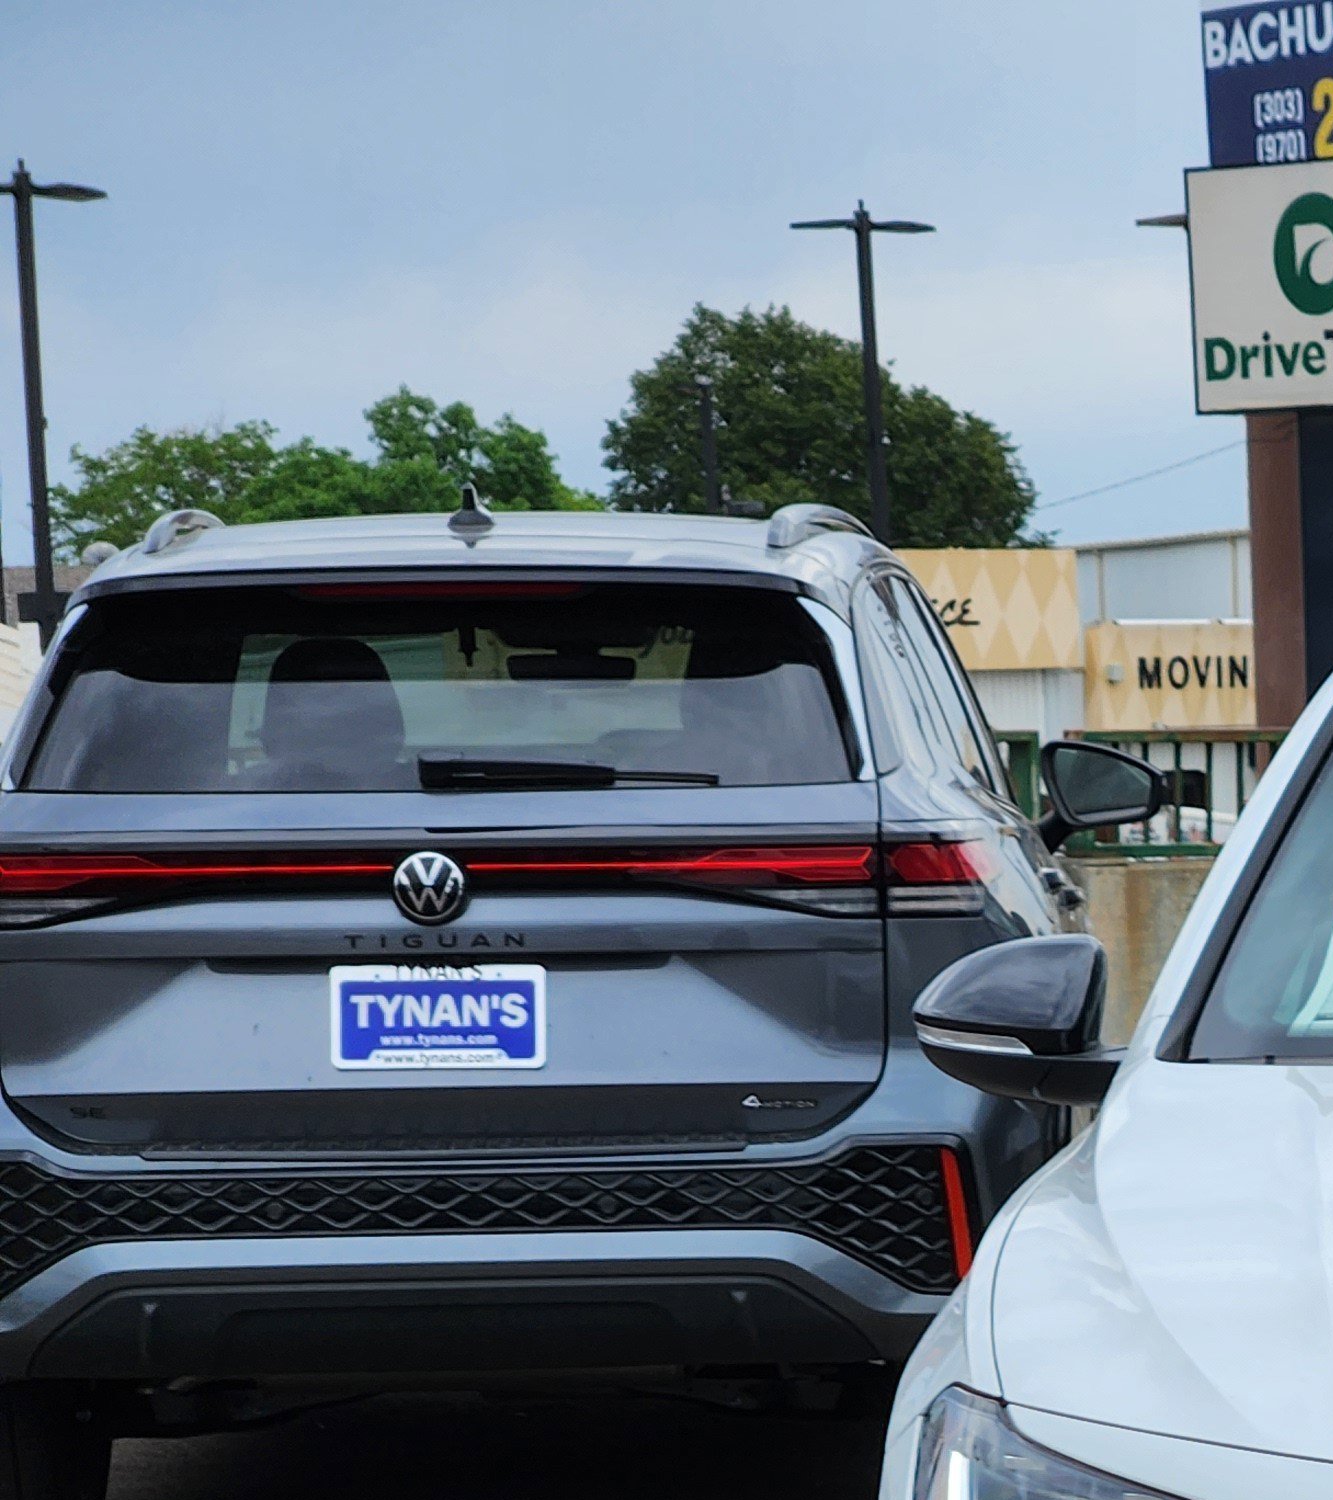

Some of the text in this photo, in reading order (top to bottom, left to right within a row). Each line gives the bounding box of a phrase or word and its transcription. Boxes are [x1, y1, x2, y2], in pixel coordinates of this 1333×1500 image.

[1137, 654, 1249, 691] MOVIN
[344, 931, 526, 949] TIGUAN
[349, 992, 529, 1029] TYNAN'S
